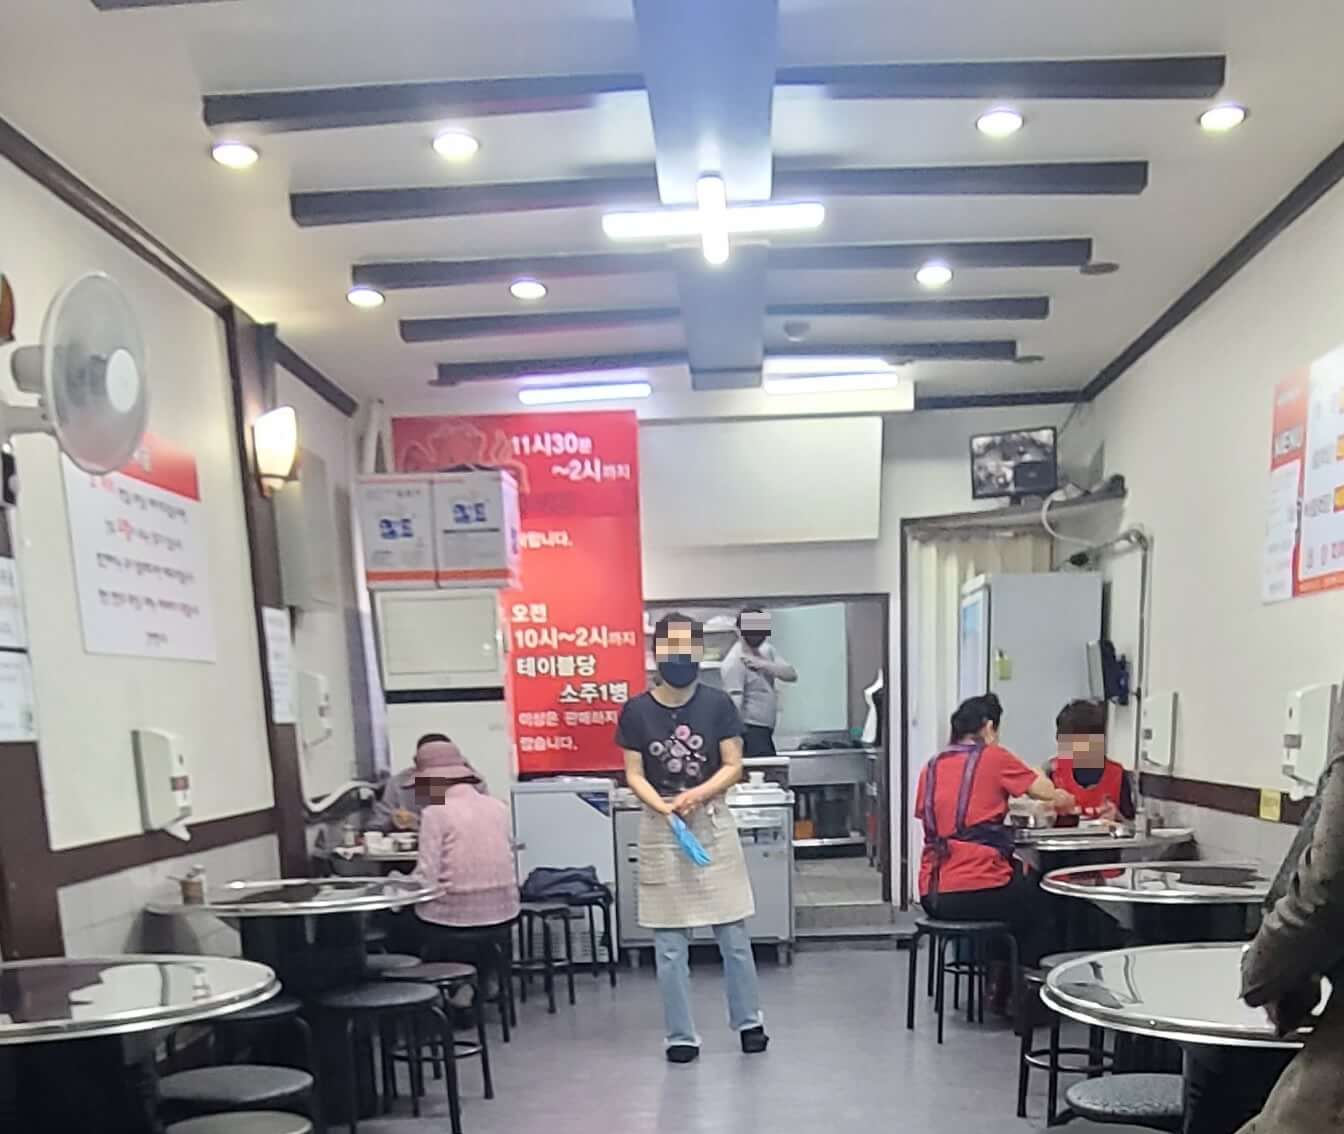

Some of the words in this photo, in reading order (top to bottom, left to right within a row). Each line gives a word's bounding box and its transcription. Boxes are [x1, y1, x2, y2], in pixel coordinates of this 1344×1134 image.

[511, 603, 548, 623] 오전
[514, 625, 637, 649] 10시~2시까지
[516, 654, 596, 677] 테이블당
[560, 681, 629, 704] 소주1병
